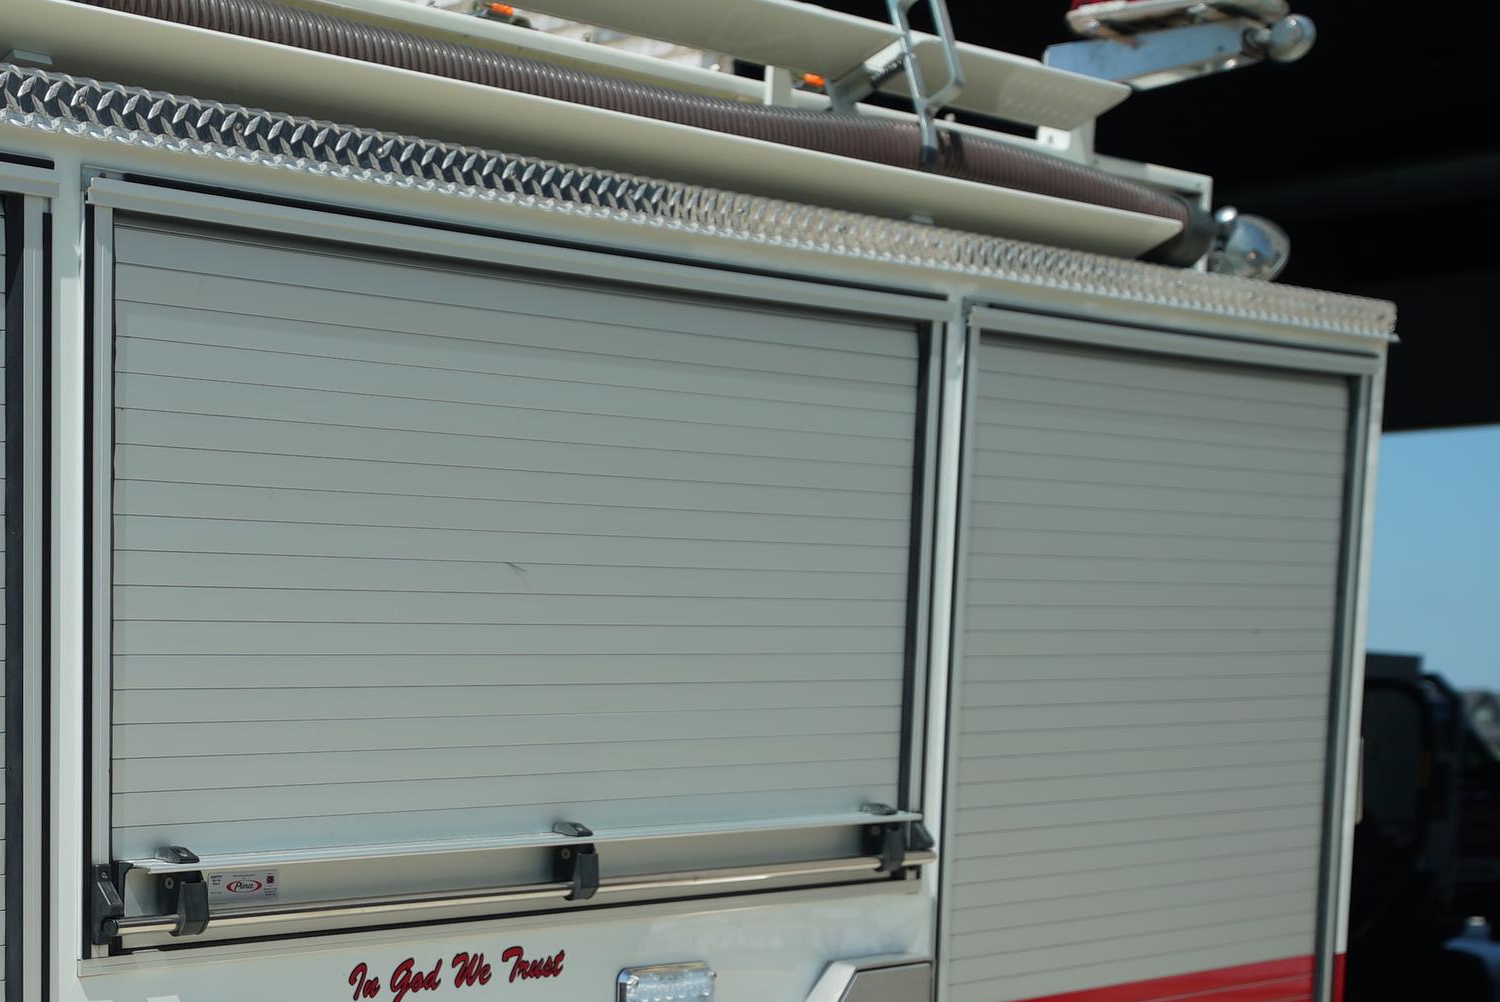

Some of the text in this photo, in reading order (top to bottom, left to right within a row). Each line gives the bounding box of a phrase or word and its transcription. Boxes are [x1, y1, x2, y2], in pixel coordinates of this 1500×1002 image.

[348, 962, 380, 1001] In
[452, 952, 492, 988] We
[502, 946, 565, 983] Trust
